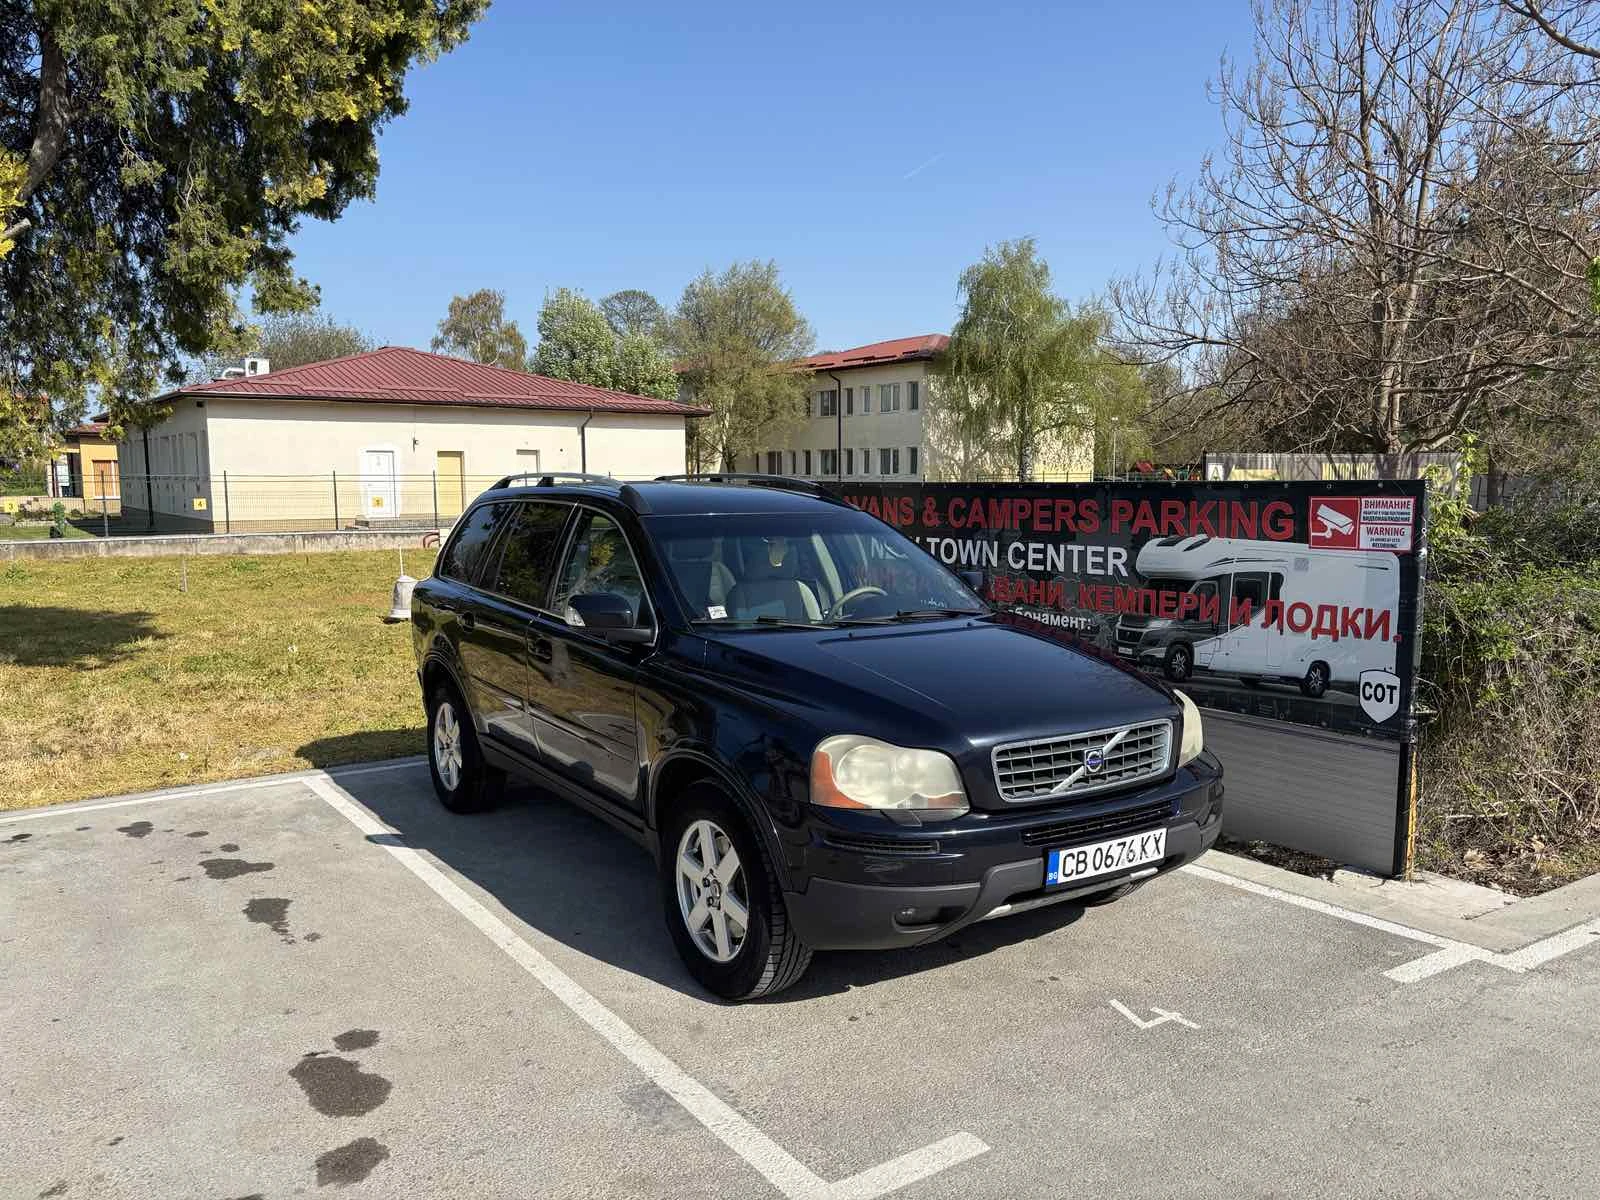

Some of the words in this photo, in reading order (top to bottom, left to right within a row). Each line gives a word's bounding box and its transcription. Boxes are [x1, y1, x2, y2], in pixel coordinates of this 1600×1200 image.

[921, 497, 942, 528] &
[950, 497, 1100, 535] CAMPERS
[1111, 498, 1295, 541] PARKING
[1364, 499, 1411, 510] ВНИМАНИЕ
[1366, 526, 1405, 537] WARNING
[926, 537, 999, 568] TOWN
[1007, 541, 1129, 577] CENTER
[1008, 607, 1092, 631] бонамент:
[1079, 583, 1220, 626] КЕМПЕРИ
[1062, 850, 1088, 878] CB
[1092, 839, 1137, 872] 0676
[1139, 832, 1163, 861] KX
